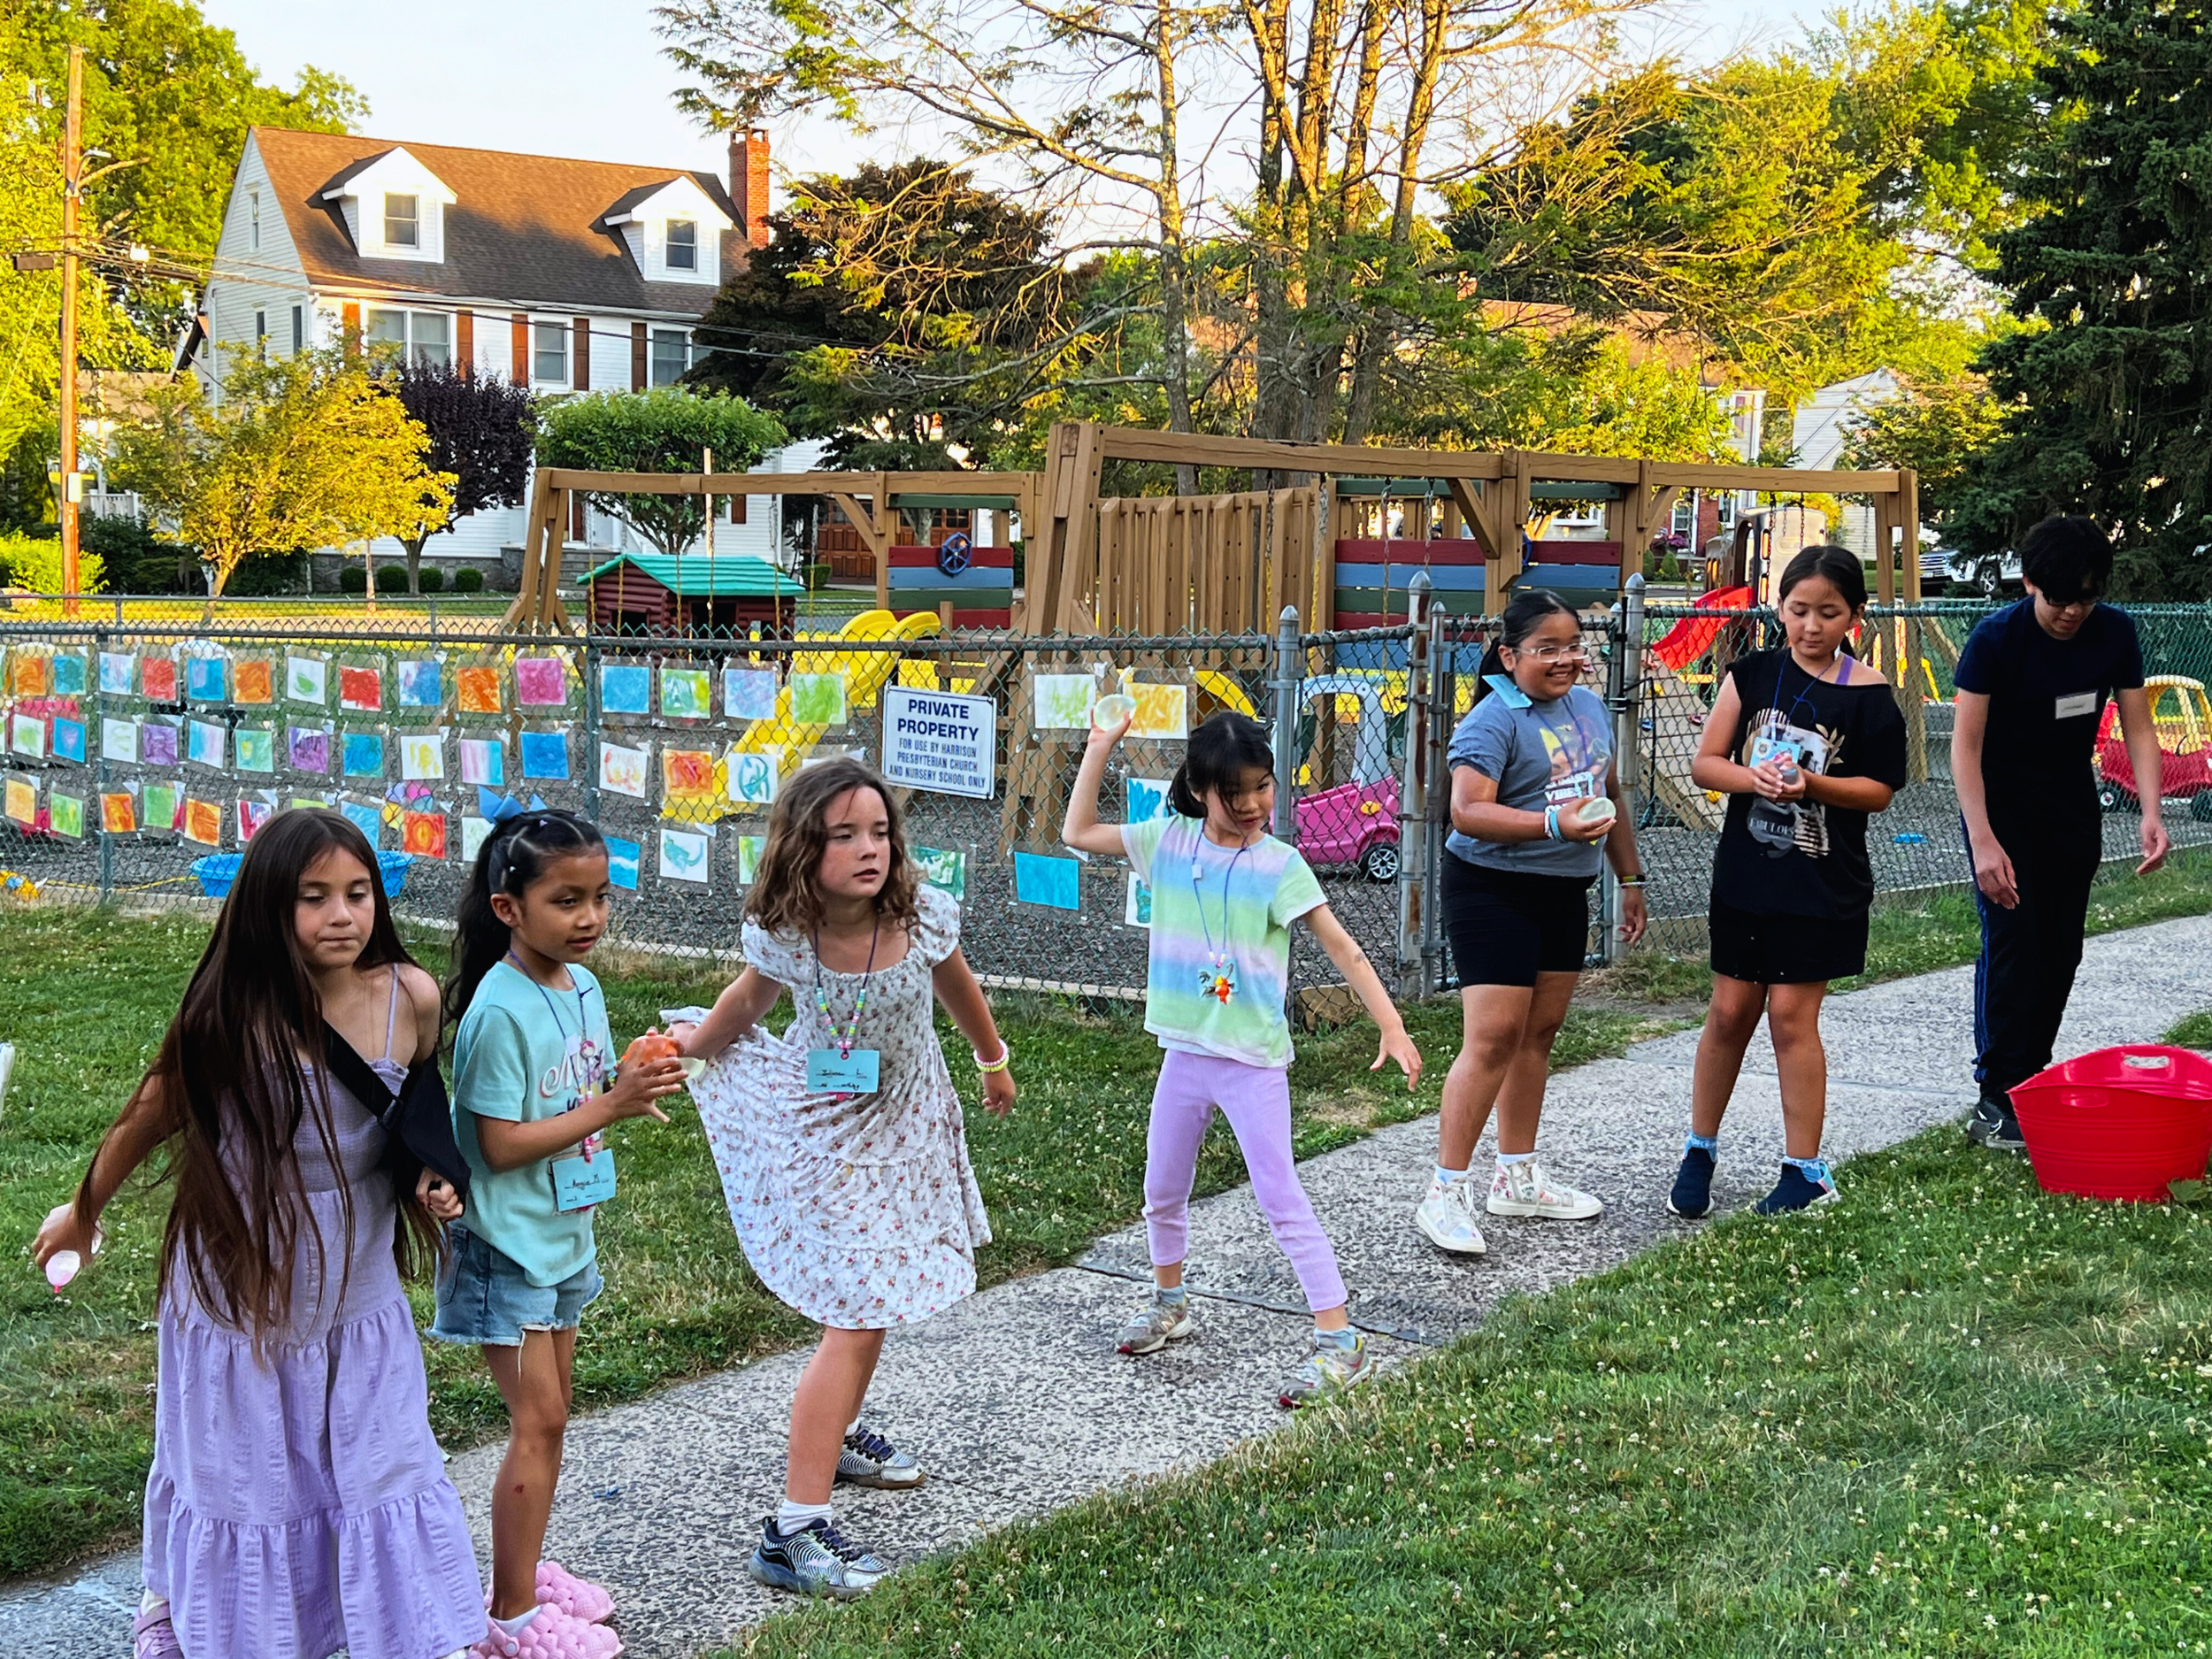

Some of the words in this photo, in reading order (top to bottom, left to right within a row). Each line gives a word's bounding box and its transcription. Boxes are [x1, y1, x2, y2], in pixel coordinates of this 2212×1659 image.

[908, 699, 969, 719] PRIVATE
[897, 718, 979, 741] PROPERTY
[899, 737, 912, 749] FOR
[914, 739, 927, 752] USE
[930, 741, 940, 753] BY
[941, 743, 977, 758] HARRISON
[897, 751, 947, 769] PRESBYTERIAN
[949, 758, 978, 772] CHURCH
[889, 764, 902, 777] AND
[905, 766, 937, 781] NURSERY
[939, 771, 965, 786] SCHOOL
[968, 775, 986, 788] ONLY
